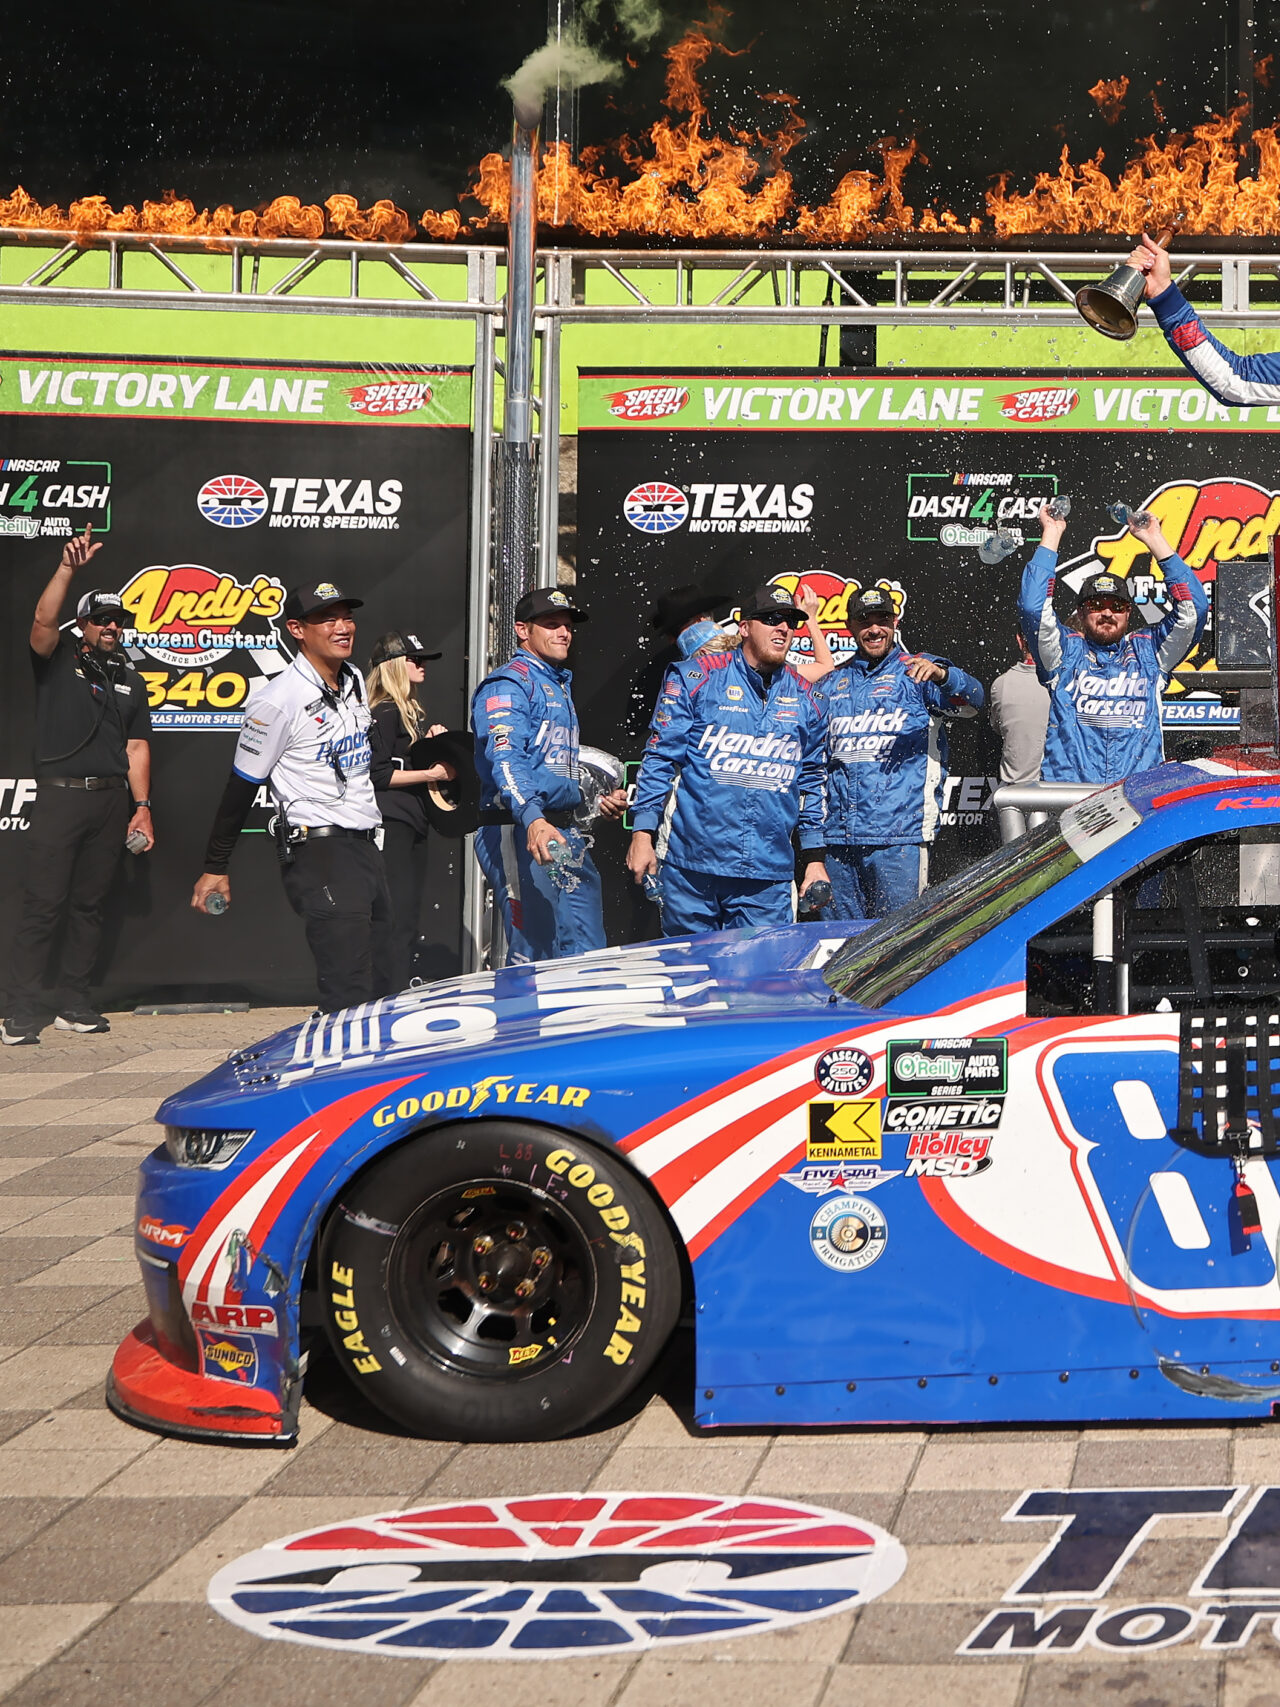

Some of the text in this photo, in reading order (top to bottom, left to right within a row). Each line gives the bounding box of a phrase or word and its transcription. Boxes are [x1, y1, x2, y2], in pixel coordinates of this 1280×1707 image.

[18, 369, 329, 413] VICTORY LANE
[365, 383, 430, 401] SPEEDY
[625, 387, 688, 405] SPEEDY
[1016, 388, 1078, 408] SPEEDY
[703, 387, 984, 420] VICTORY LANE
[7, 459, 60, 473] NASCAR
[968, 473, 1013, 485] NASCAR
[9, 475, 38, 512] 4
[42, 485, 110, 509] CASH
[269, 477, 403, 515] TEXAS
[689, 484, 815, 519] TEXAS
[907, 488, 994, 523] DASH 4
[40, 526, 73, 536] PARTS
[44, 517, 70, 527] AUTO
[269, 515, 319, 528] MOTOR
[689, 520, 737, 533] MOTOR
[121, 569, 284, 634] Andy's
[122, 629, 279, 650] Frozen Custard
[161, 652, 216, 664] SINCE 1986
[138, 671, 248, 708] 340
[1076, 695, 1146, 716] Cars.com
[1208, 706, 1240, 719] MOT
[174, 714, 211, 724] MOTOR
[710, 752, 796, 780] Cars.com
[934, 1038, 972, 1049] NASCAR
[823, 1050, 865, 1067] NASCAR
[899, 1055, 961, 1078] O'Reilly
[967, 1055, 996, 1067] AUTO
[830, 1066, 859, 1076] 250
[965, 1066, 1000, 1079] PARTS
[820, 1075, 869, 1093] SALUTES
[931, 1086, 963, 1096] SERIES
[372, 1075, 592, 1128] GOODYEAR
[887, 1101, 1002, 1127] COMETIC
[809, 1147, 878, 1157] KENNAMETAL
[908, 1133, 991, 1160] Holley
[803, 1168, 877, 1180] FIVE STAR
[904, 1158, 979, 1177] MSD
[819, 1200, 878, 1223] CHAMPION
[545, 1149, 647, 1366] GOODYEAR
[818, 1242, 880, 1267] IRRIGATION
[191, 1303, 276, 1328] ARP
[332, 1261, 382, 1374] EAGLE
[206, 1346, 254, 1366] SUNOCO
